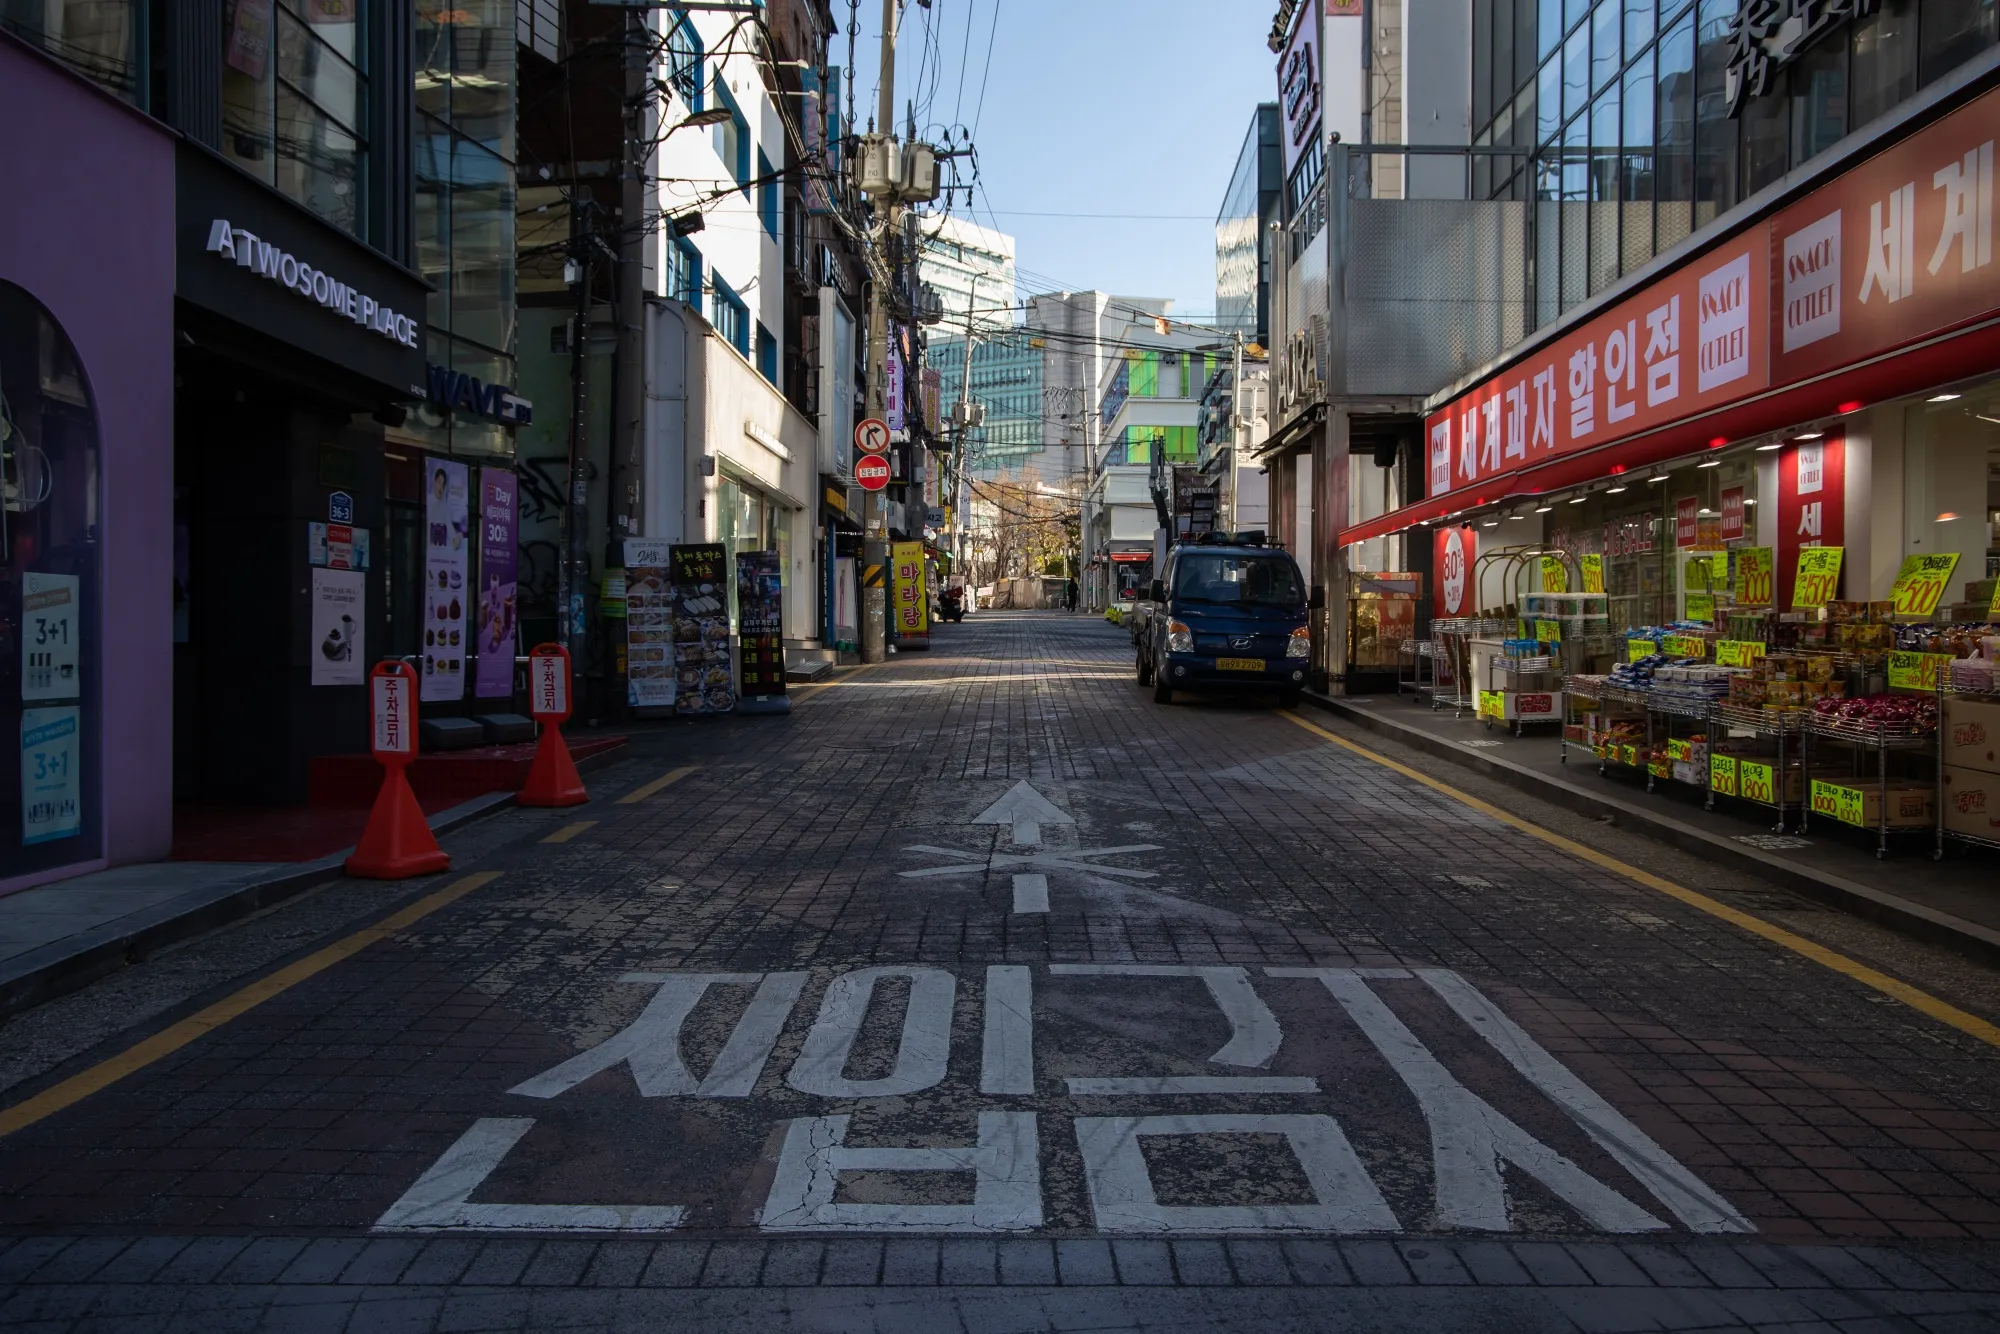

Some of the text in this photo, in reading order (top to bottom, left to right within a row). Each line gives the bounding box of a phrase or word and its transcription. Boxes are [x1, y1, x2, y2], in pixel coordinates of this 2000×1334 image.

[1858, 139, 1994, 304] 세계
[1788, 236, 1834, 284] SNACK
[1700, 272, 1745, 324] SNACK
[1787, 283, 1833, 330] OUTLET
[355, 295, 418, 349] PLACE
[1700, 325, 1745, 374] OUTLET
[1458, 294, 1680, 482] 세계과자 할인점
[1431, 429, 1448, 454] SNACK
[860, 467, 886, 478] 진입금지
[331, 505, 350, 520] 36-3
[900, 561, 921, 627] 마라탕
[1744, 570, 1772, 603] 1000
[1803, 573, 1836, 604] 1500
[1896, 578, 1942, 613] 500
[35, 619, 67, 645] 3+1
[542, 658, 556, 711] 주차금지
[385, 679, 399, 750] 주차금지
[34, 749, 68, 781] 3+1
[1713, 771, 1734, 794] 500
[1744, 778, 1770, 801] 800
[1814, 794, 1837, 813] 1000
[1840, 808, 1861, 825] 1000
[371, 963, 1760, 1235] 진입금지
